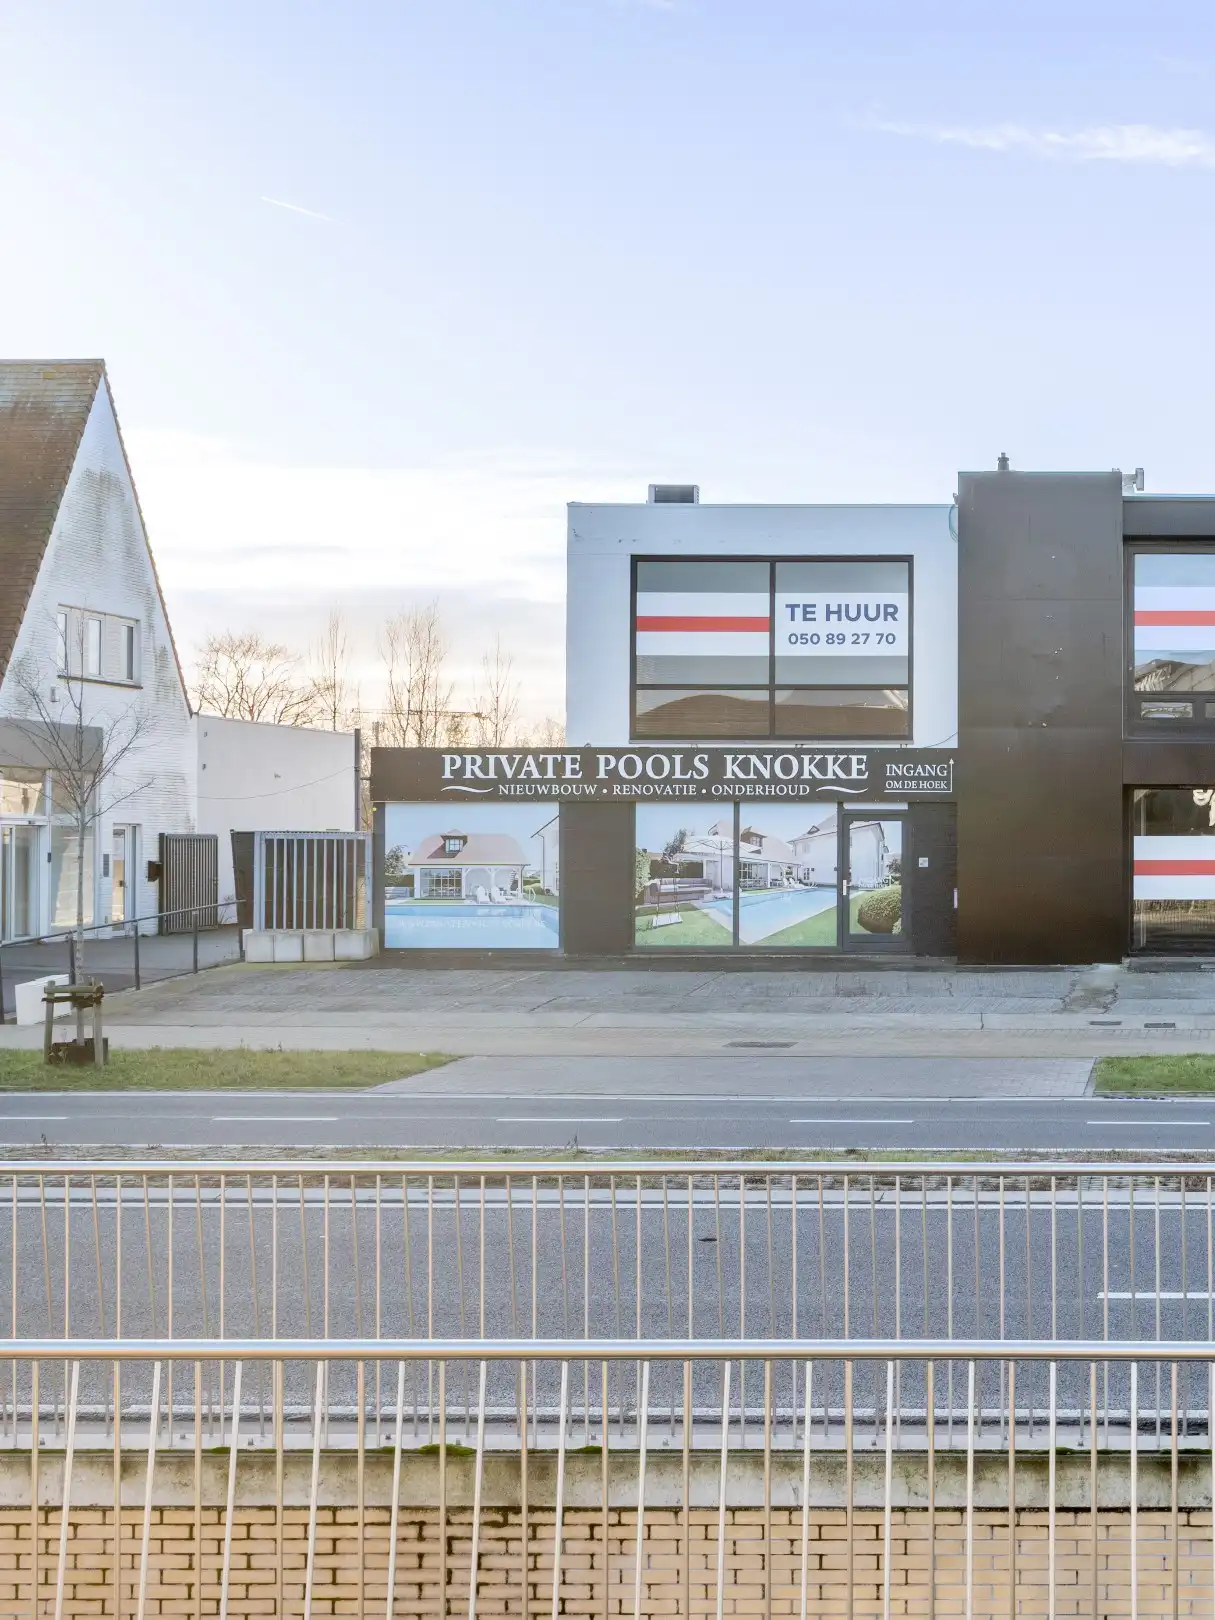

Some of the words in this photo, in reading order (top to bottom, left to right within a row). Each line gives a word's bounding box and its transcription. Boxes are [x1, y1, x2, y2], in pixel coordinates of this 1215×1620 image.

[785, 603, 816, 622] TE
[825, 603, 899, 622] HUUR
[788, 632, 821, 645] 050
[825, 632, 846, 645] 89
[850, 632, 871, 645] 27
[875, 632, 896, 645] 70
[441, 754, 583, 779] PRIVATE
[596, 754, 709, 780] POOLS
[723, 754, 869, 780] KNOKKE
[886, 764, 947, 777] INGANG
[498, 784, 598, 796] NIEUWBOUW
[612, 784, 697, 796] RENOVATIE
[711, 784, 810, 796] ONDERHOUD
[886, 780, 903, 789] OM
[904, 780, 918, 789] DE
[919, 780, 947, 789] HOEK
